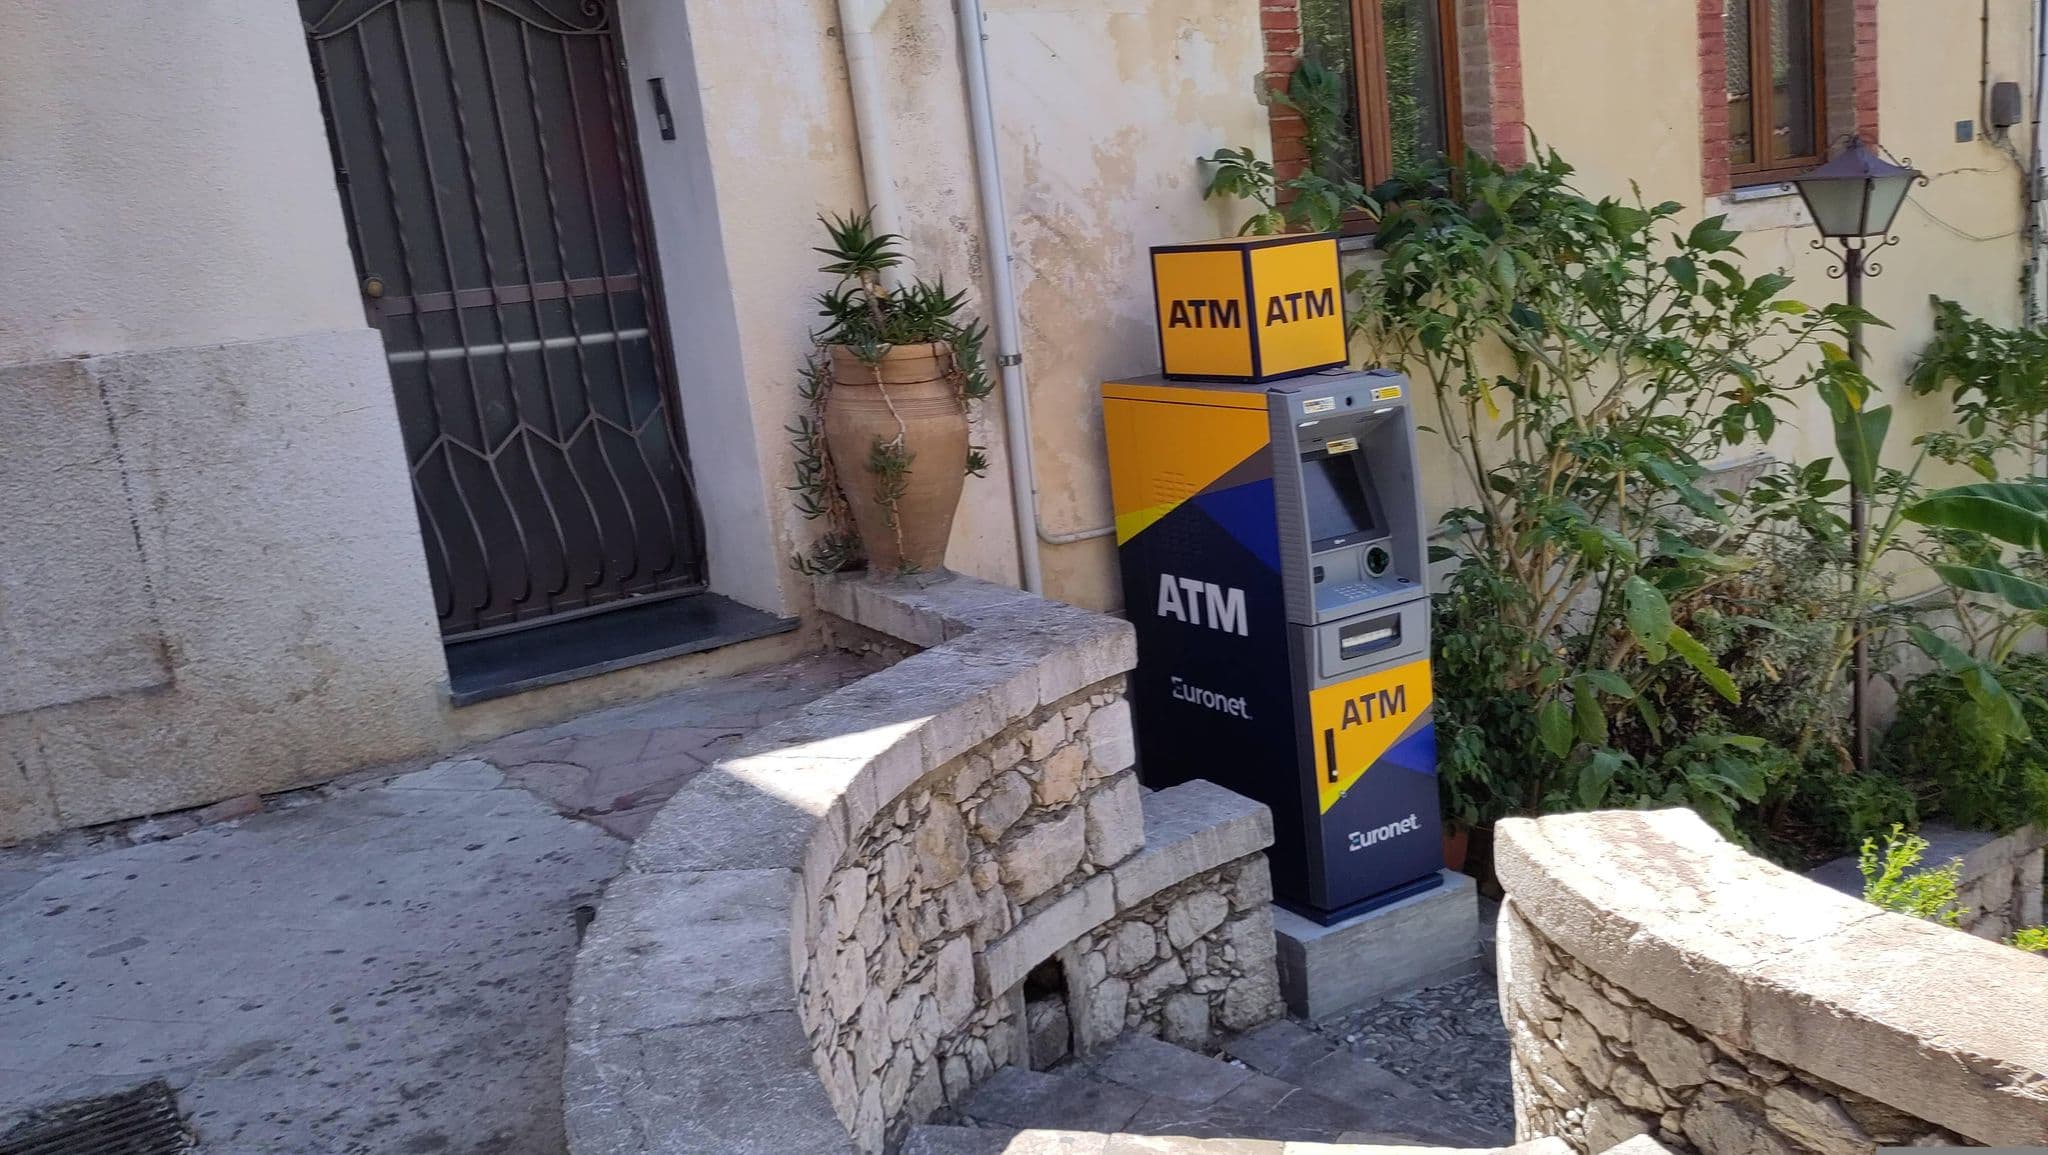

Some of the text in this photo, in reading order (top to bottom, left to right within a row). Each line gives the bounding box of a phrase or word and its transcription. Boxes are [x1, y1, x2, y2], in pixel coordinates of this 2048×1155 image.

[1168, 299, 1240, 329] ATM
[1266, 287, 1335, 327] ATM
[1157, 573, 1249, 637] ATM
[1170, 676, 1252, 720] Euronet
[1341, 684, 1406, 731] ATM
[1348, 812, 1421, 852] Euronet
